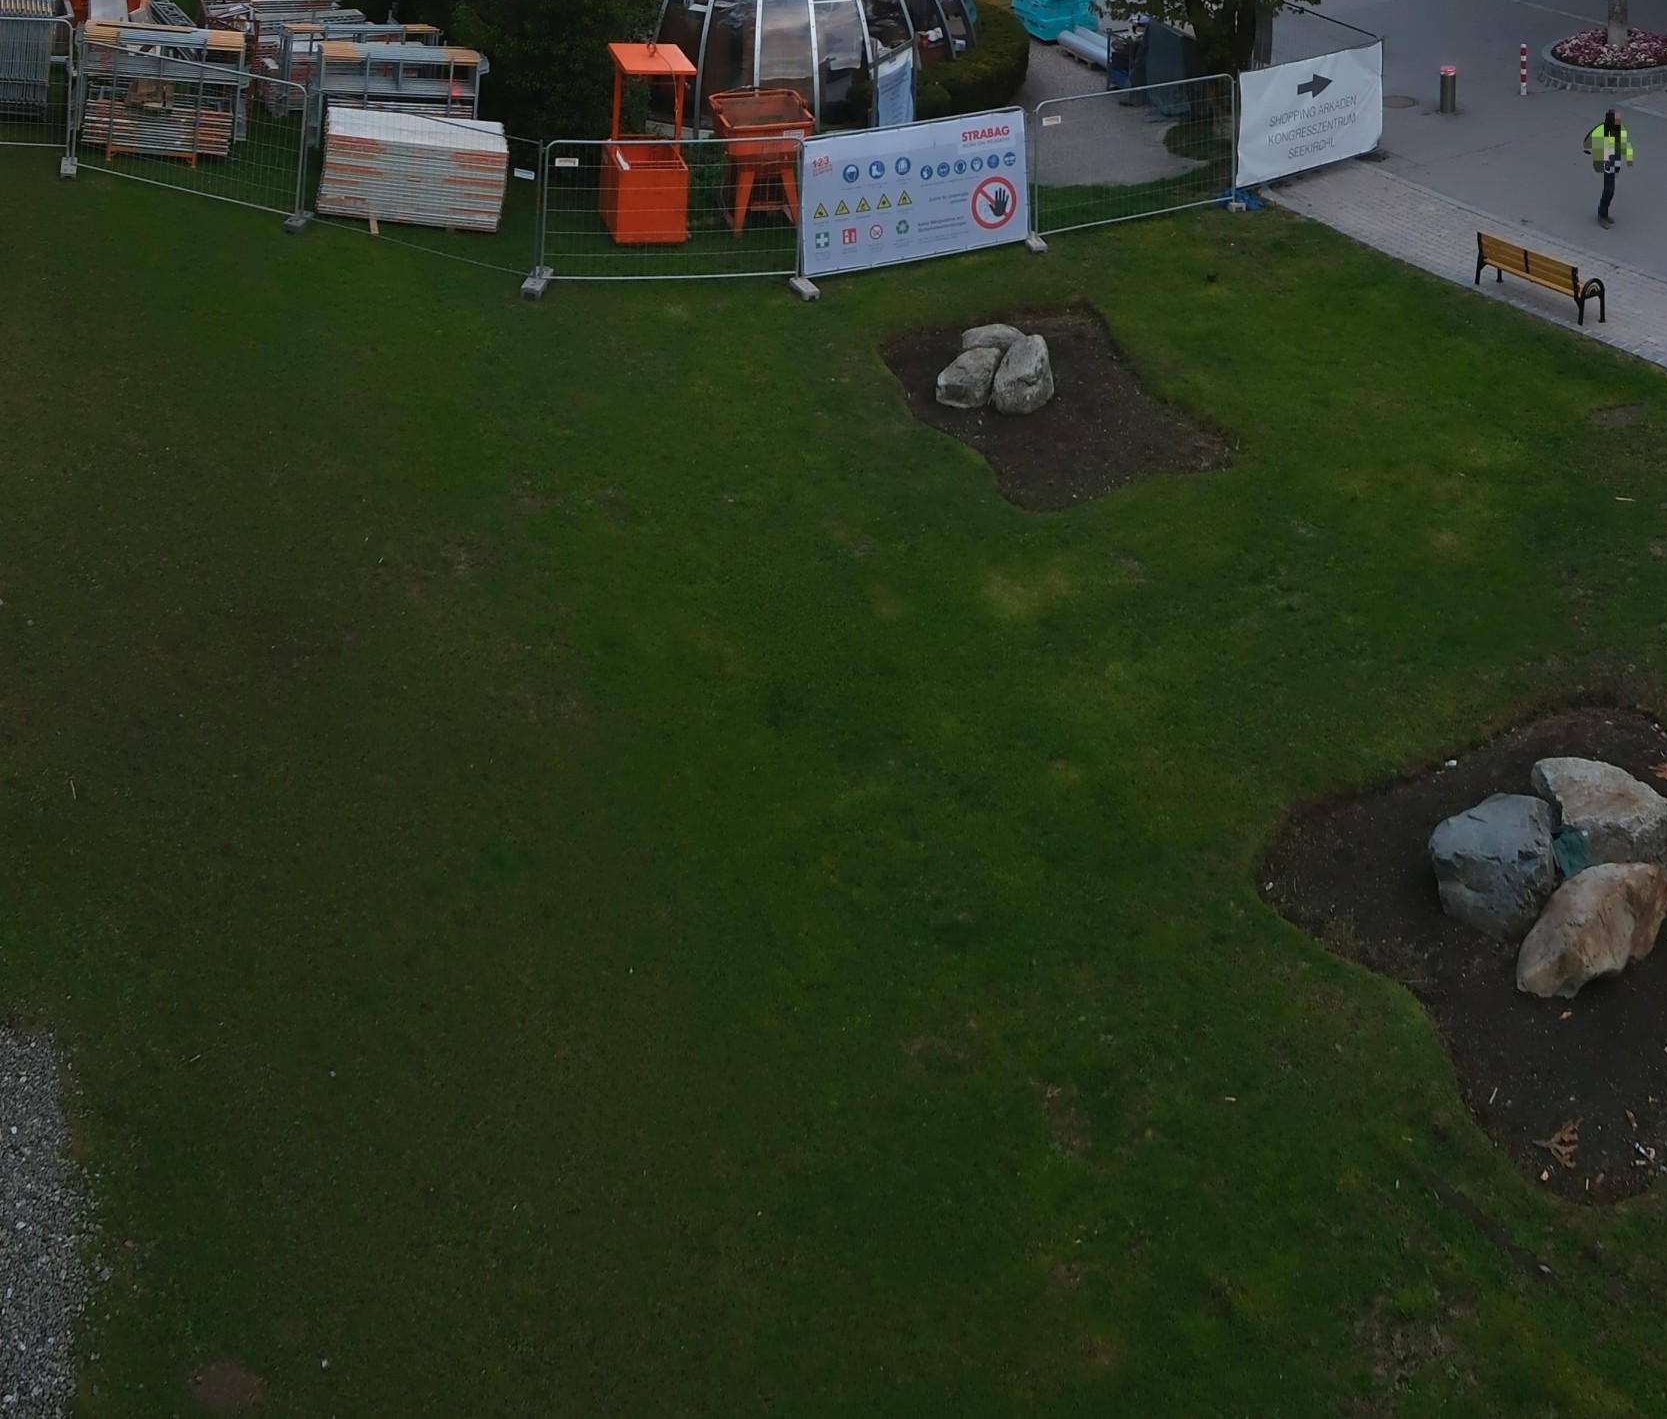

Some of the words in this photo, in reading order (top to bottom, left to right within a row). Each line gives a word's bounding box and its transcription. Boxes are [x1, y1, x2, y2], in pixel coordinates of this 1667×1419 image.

[1269, 106, 1316, 128] SHOPPING
[1317, 95, 1357, 116] ARKADEN
[961, 125, 1010, 142] STRABAG
[1268, 113, 1357, 146] KONGRESSZENTRUM
[1287, 138, 1336, 160] SEEKIRCHL
